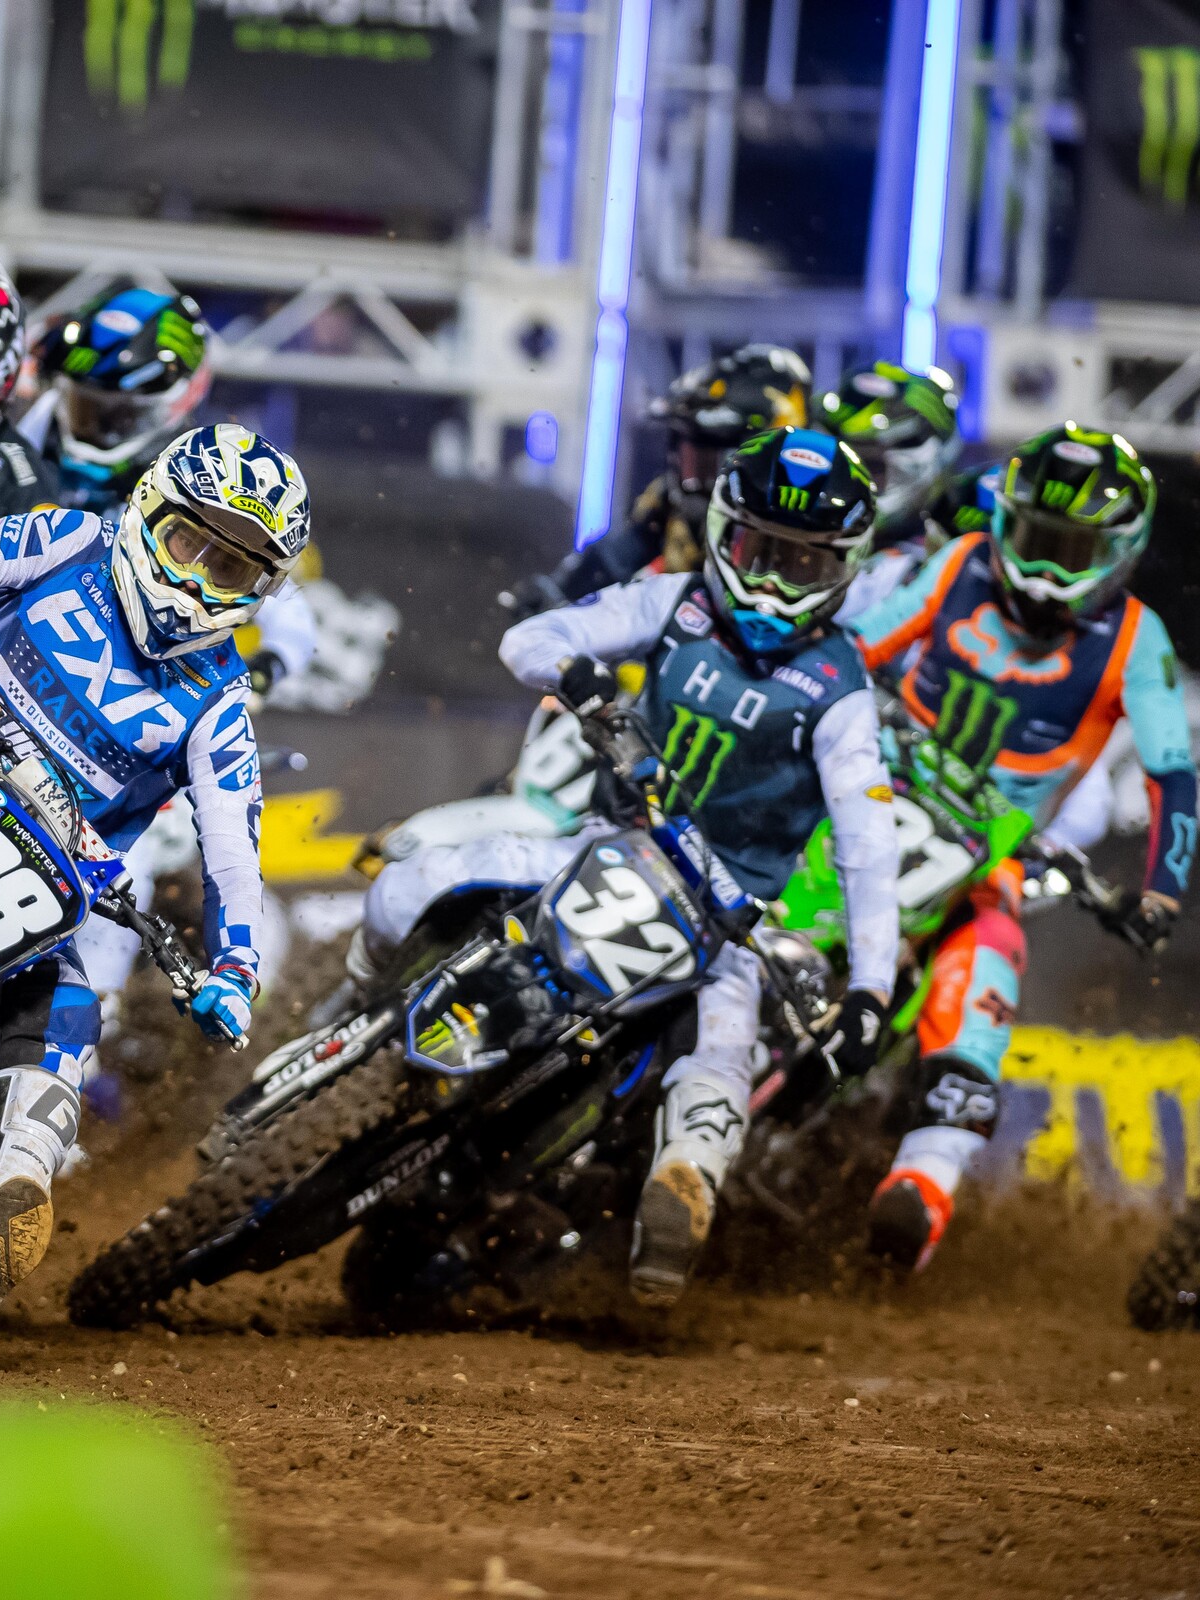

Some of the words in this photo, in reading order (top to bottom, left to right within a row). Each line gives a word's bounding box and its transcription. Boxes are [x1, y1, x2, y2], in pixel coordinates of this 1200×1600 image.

[239, 498, 273, 526] SHOEI
[26, 588, 188, 754] FXR
[27, 665, 109, 756] RACE
[27, 702, 75, 758] DIVISION
[12, 822, 59, 877] MONSTER
[13, 835, 47, 872] ENERGY
[554, 866, 697, 995] 32
[347, 1133, 450, 1218] DUNLOP
